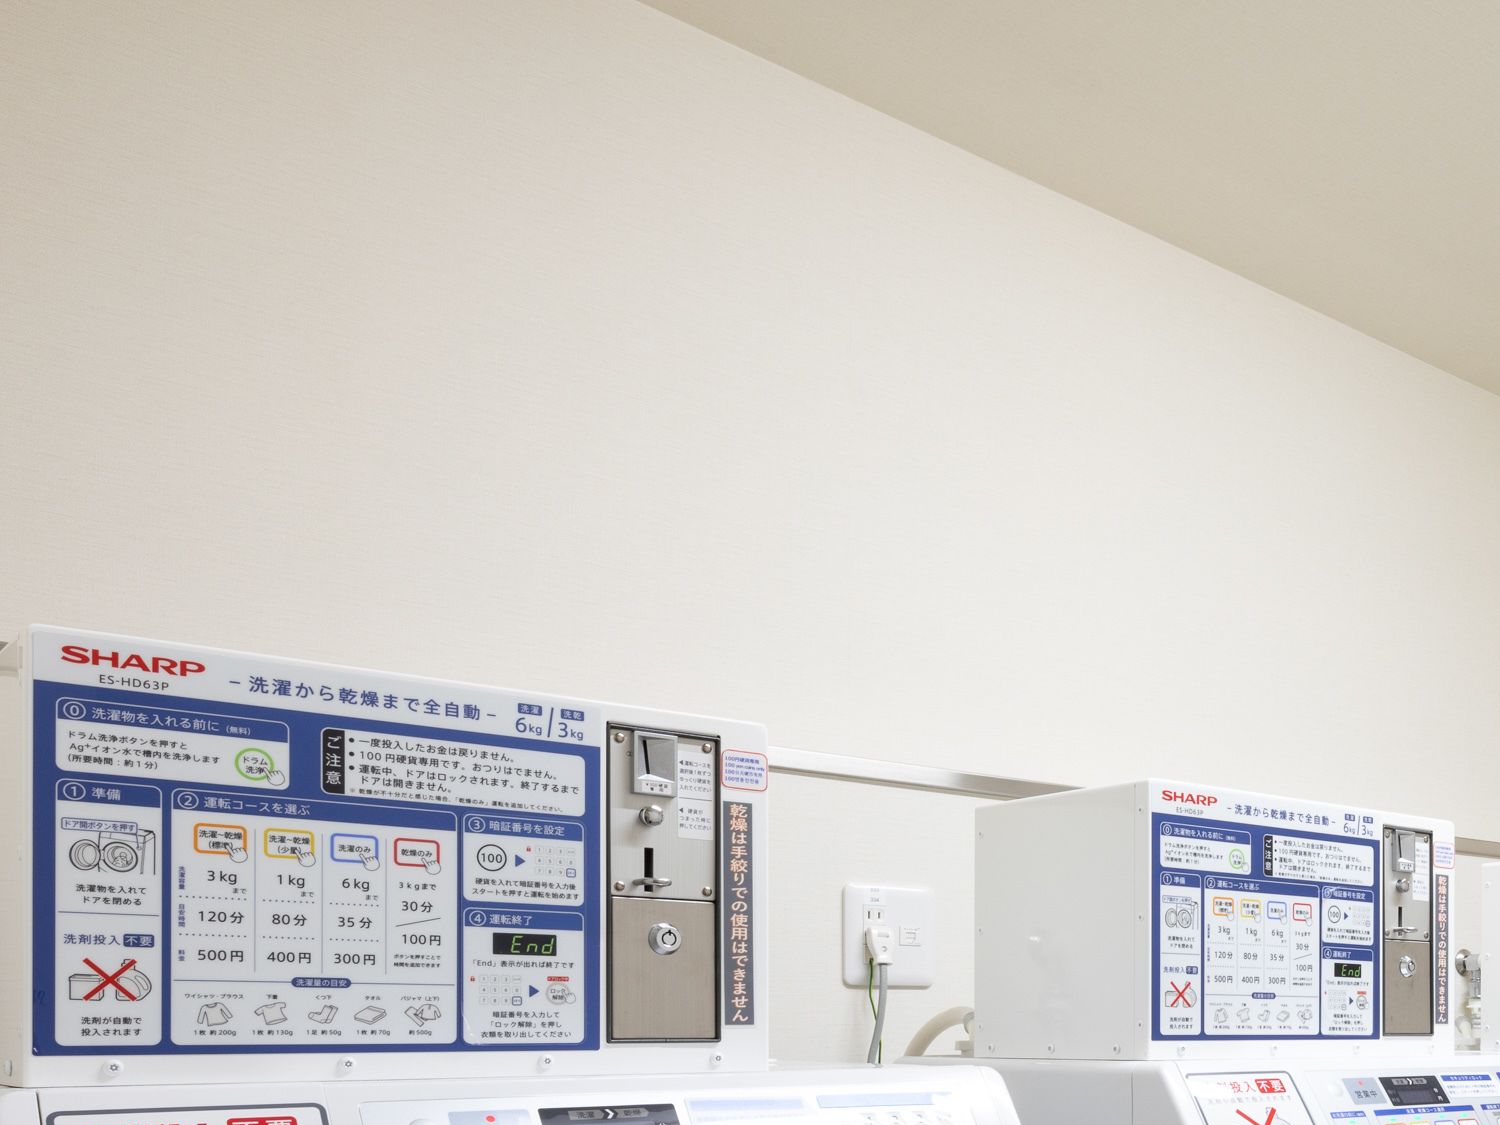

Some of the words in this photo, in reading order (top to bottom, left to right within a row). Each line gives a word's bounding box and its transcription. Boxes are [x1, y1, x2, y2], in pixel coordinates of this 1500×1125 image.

[61, 645, 206, 676] SHARP
[99, 674, 169, 691] ES-HD63P
[325, 735, 342, 786] ご注意
[204, 797, 310, 816] 運転コースを選ぶ
[1162, 790, 1217, 807] SHARP
[480, 852, 503, 864] 100
[729, 803, 749, 1022] 乾燥は手絞りでの使用はできません
[510, 935, 555, 955] End
[1341, 964, 1362, 977] End
